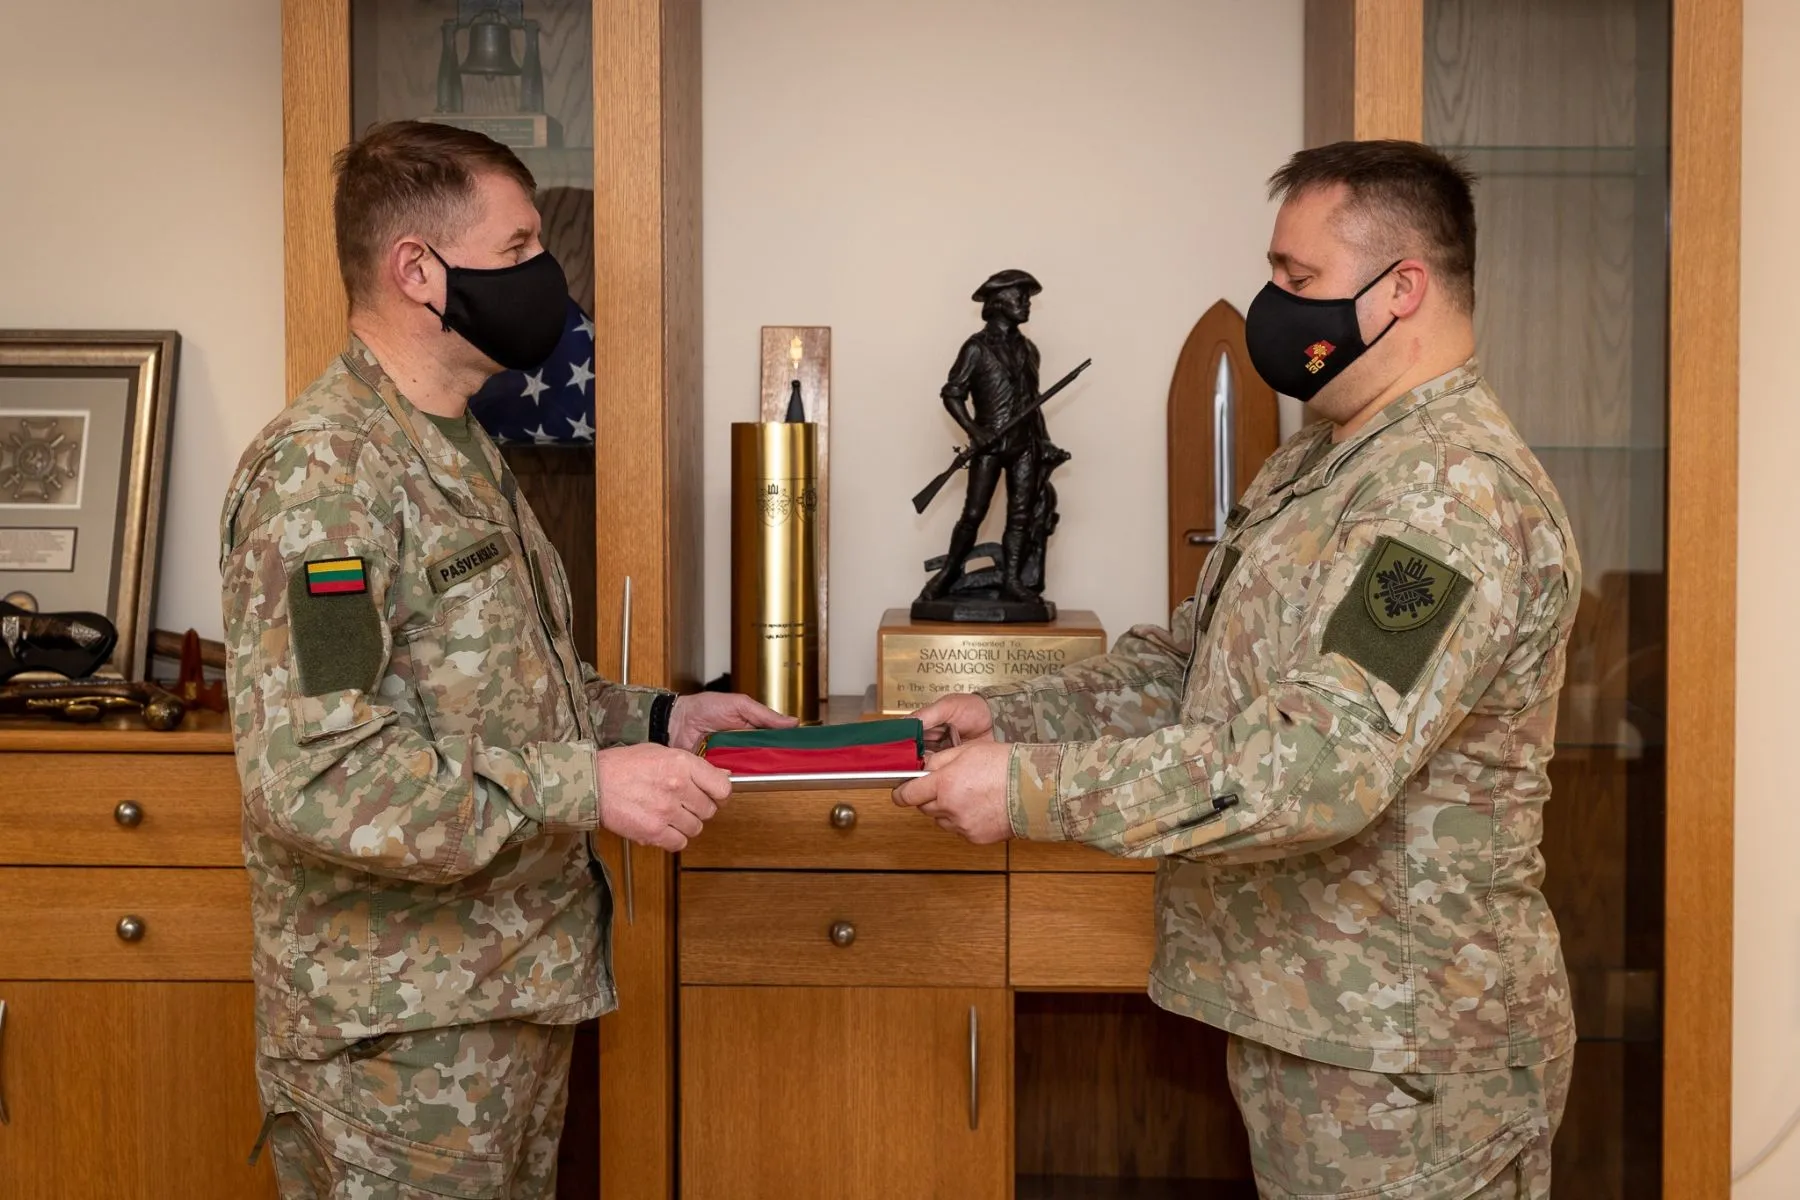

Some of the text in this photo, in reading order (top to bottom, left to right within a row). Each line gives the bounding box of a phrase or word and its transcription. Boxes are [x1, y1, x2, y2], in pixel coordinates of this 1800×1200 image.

[1309, 359, 1325, 373] 30
[962, 640, 1005, 648] Presented
[919, 648, 1065, 661] SAVANORIU KRASTO
[916, 662, 995, 675] APSAUGOS
[897, 683, 905, 692] In
[910, 683, 925, 692] The
[929, 683, 950, 693] Spirit
[953, 683, 965, 692] Of
